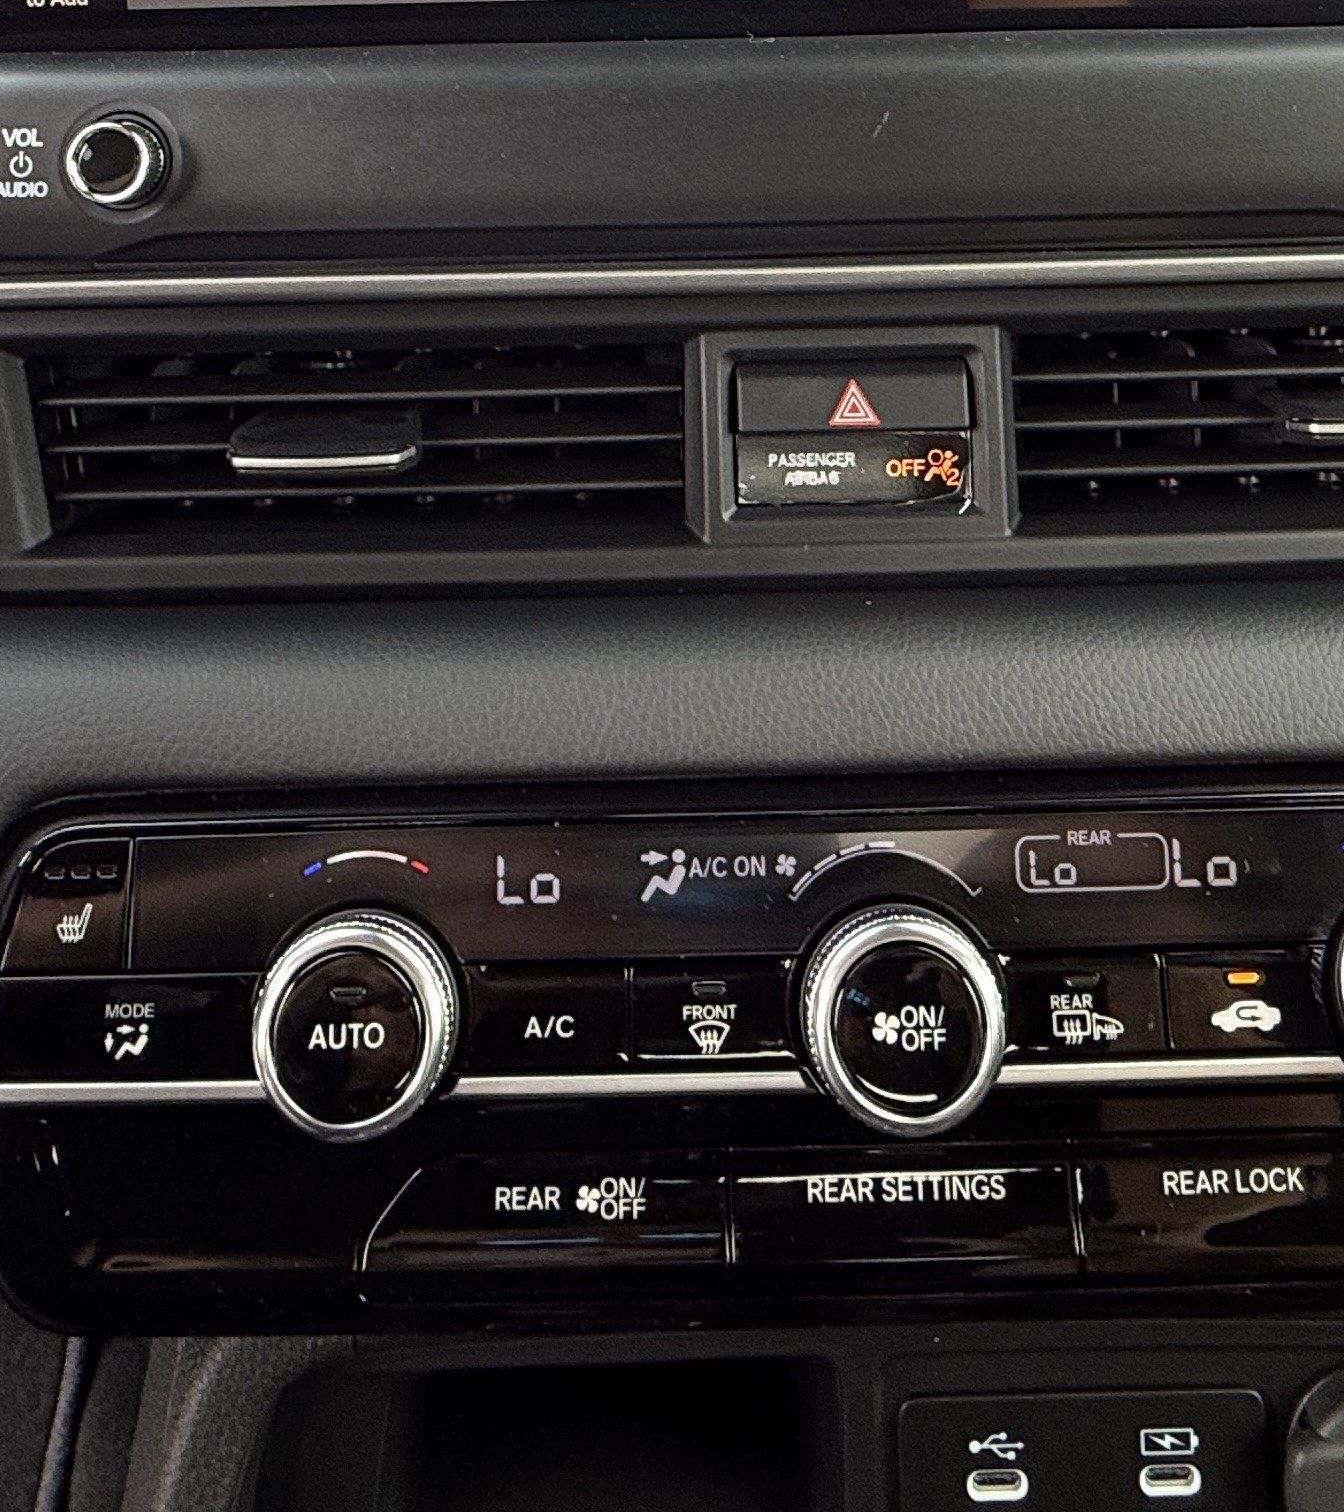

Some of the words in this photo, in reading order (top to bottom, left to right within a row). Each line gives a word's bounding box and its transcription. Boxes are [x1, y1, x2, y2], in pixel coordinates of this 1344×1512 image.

[1, 128, 44, 147] VOL
[768, 451, 856, 468] PASSENGER
[885, 458, 927, 477] OFF
[784, 470, 841, 486] AIRBAG
[1067, 829, 1112, 846] REAR
[689, 855, 728, 878] A/C
[734, 855, 766, 877] ON
[104, 1002, 155, 1019] MODE
[682, 1004, 737, 1021] FRONT
[1050, 994, 1093, 1011] REAR
[523, 1014, 576, 1039] A/C
[901, 1005, 946, 1029] ON/
[308, 1023, 386, 1050] AUTO
[902, 1030, 947, 1052] OFF
[600, 1176, 646, 1199] ON/
[807, 1177, 875, 1204] REAR
[882, 1174, 1007, 1202] SETTINGS
[1163, 1170, 1229, 1199] REAR
[1235, 1167, 1306, 1195] LOCK
[495, 1187, 561, 1211] REAR
[600, 1198, 647, 1220] OFF
